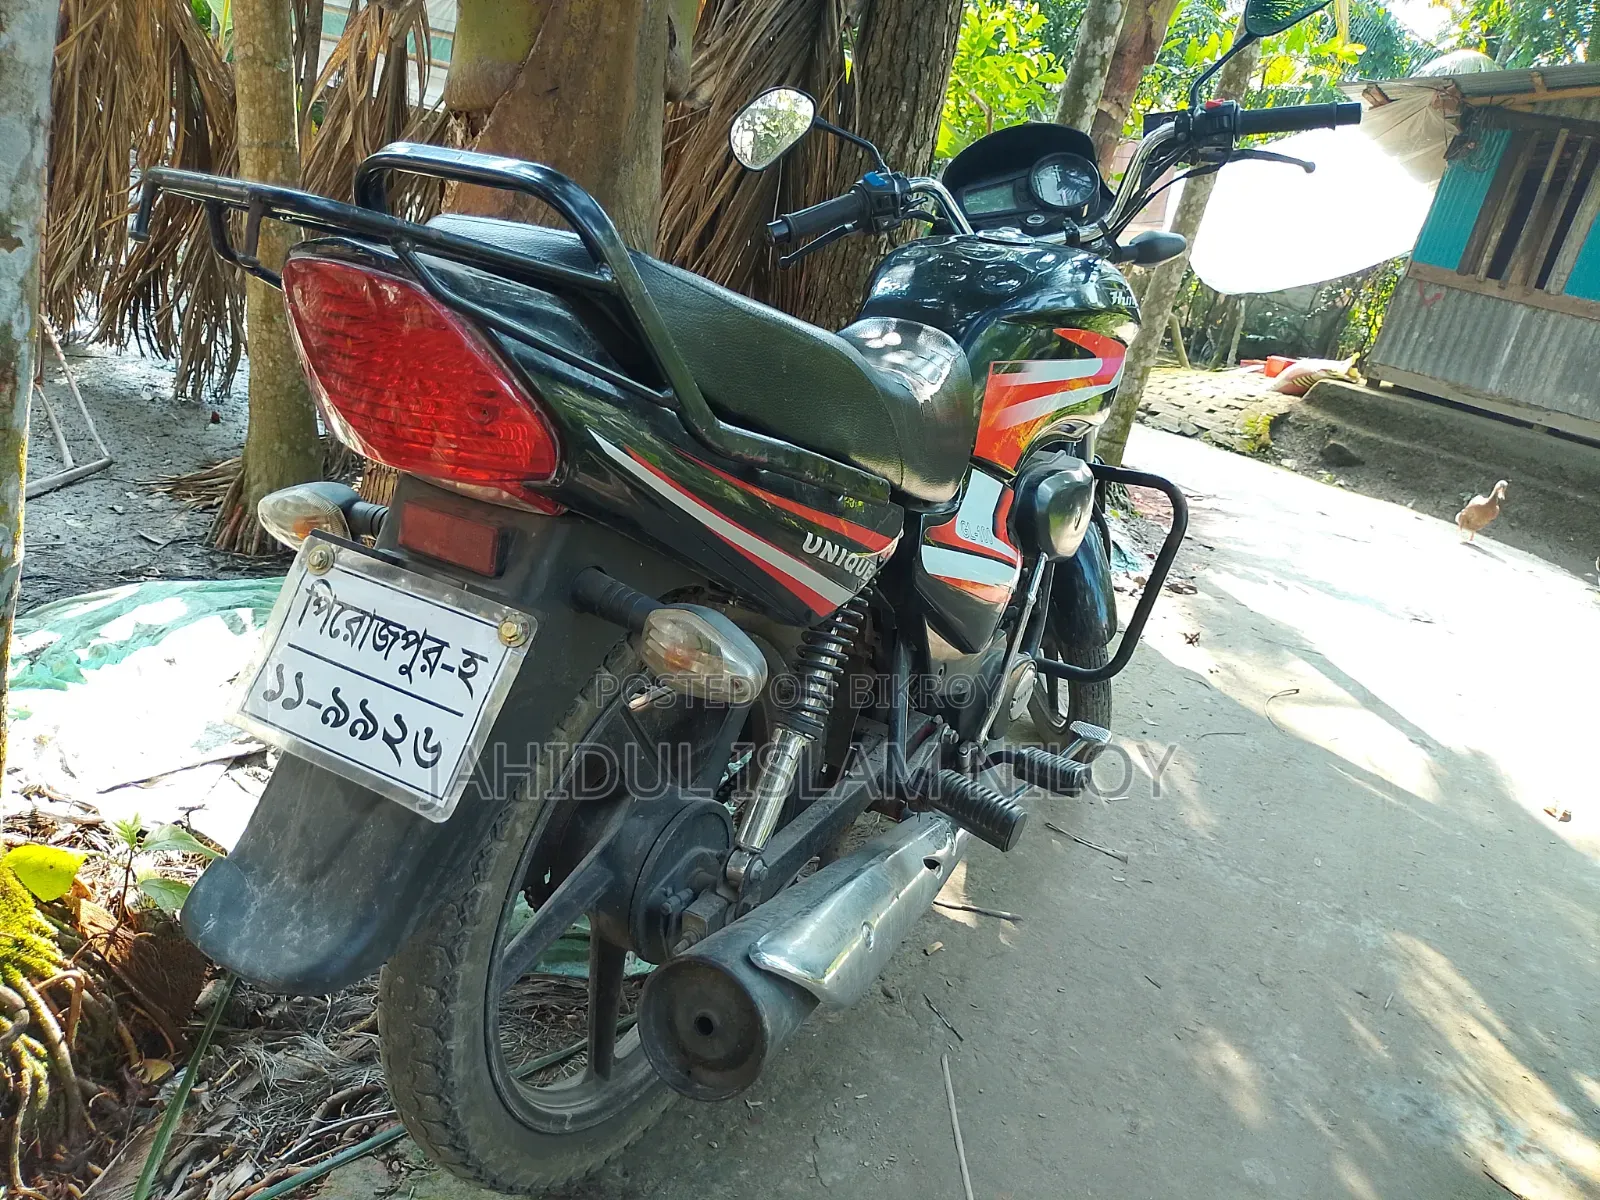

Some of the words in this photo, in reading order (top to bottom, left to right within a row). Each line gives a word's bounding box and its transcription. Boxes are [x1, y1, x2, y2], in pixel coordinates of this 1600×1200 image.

[802, 531, 877, 581] UNIQUE
[297, 578, 490, 700] পিরোজপুর-হ
[262, 663, 443, 769] ১১-৯৯২৬
